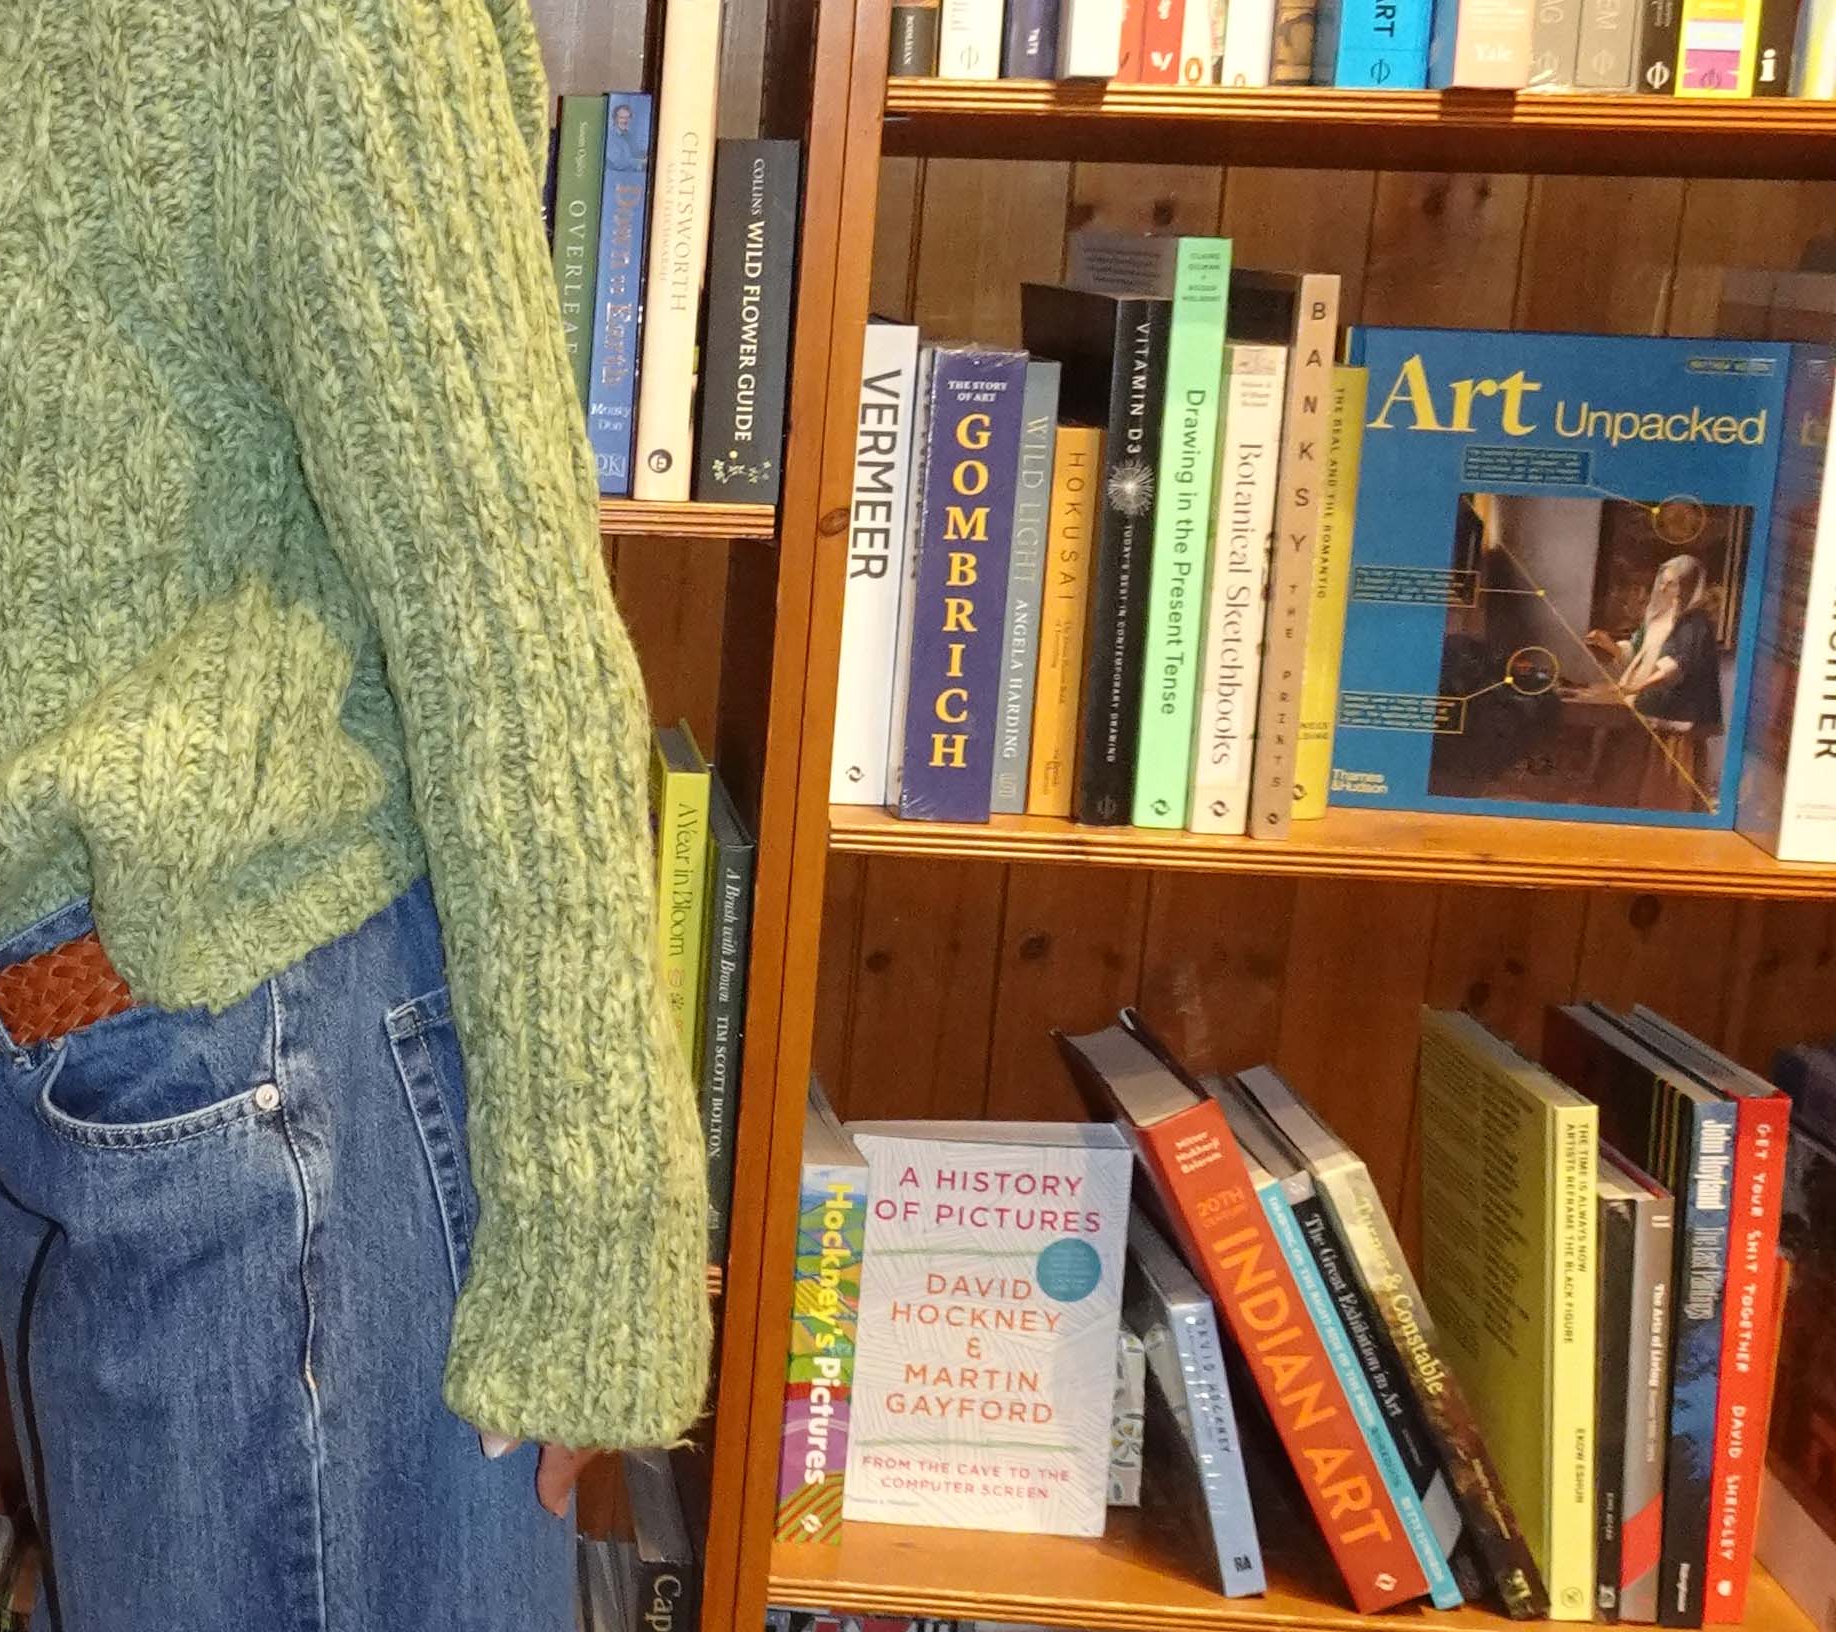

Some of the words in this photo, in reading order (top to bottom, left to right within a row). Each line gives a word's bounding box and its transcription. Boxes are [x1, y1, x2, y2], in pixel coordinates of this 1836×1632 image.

[751, 158, 765, 215] COLLINS
[744, 221, 765, 277] WILD
[738, 285, 760, 368] FLOWER
[1128, 322, 1150, 416] VITAMIN
[1369, 354, 1541, 437] Art
[1553, 401, 1765, 446] Unpacked
[734, 373, 755, 441] GUIDE
[1126, 428, 1143, 454] D3
[1175, 389, 1206, 483] Drawing
[849, 369, 902, 579] VERMEER
[1021, 416, 1049, 488] WILD
[1058, 451, 1086, 601] HOKUSAI
[1175, 519, 1198, 553] the
[1179, 493, 1200, 512] in
[1227, 443, 1263, 574] Botanical
[1014, 502, 1041, 583] LIGHT
[1010, 599, 1030, 668] ANGELA
[1166, 562, 1191, 646] Present
[1161, 652, 1184, 715] Tense
[1211, 585, 1251, 765] Sketchbooks
[1002, 676, 1025, 758] HARDING
[1755, 1124, 1771, 1160] GET
[875, 1200, 919, 1221] OF
[937, 1205, 1100, 1232] PICTURES
[900, 1167, 919, 1187] A
[937, 1169, 1083, 1197] HISTORY
[1750, 1173, 1768, 1217] YOUR
[818, 1183, 852, 1349] Hockney's
[1746, 1230, 1762, 1273] SHIT
[892, 1303, 1062, 1331] HOCKNEY
[926, 1273, 1031, 1299] DAVID
[1735, 1283, 1758, 1373] TOGETHER
[886, 1393, 1053, 1424] GAYFORD
[905, 1363, 1039, 1392] MARTIN
[1214, 1225, 1337, 1430] INDIAN
[1302, 1445, 1392, 1544] ART
[804, 1356, 842, 1485] Pictures
[1727, 1405, 1747, 1458] DAVID
[863, 1456, 911, 1473] FROM
[919, 1459, 951, 1474] THE
[957, 1461, 1000, 1477] CAVE
[1009, 1465, 1030, 1478] TO
[1037, 1465, 1069, 1481] THE
[881, 1476, 975, 1494] COMPUTER
[981, 1482, 1049, 1499] SCREEN
[1719, 1475, 1741, 1561] SHRIGLEY
